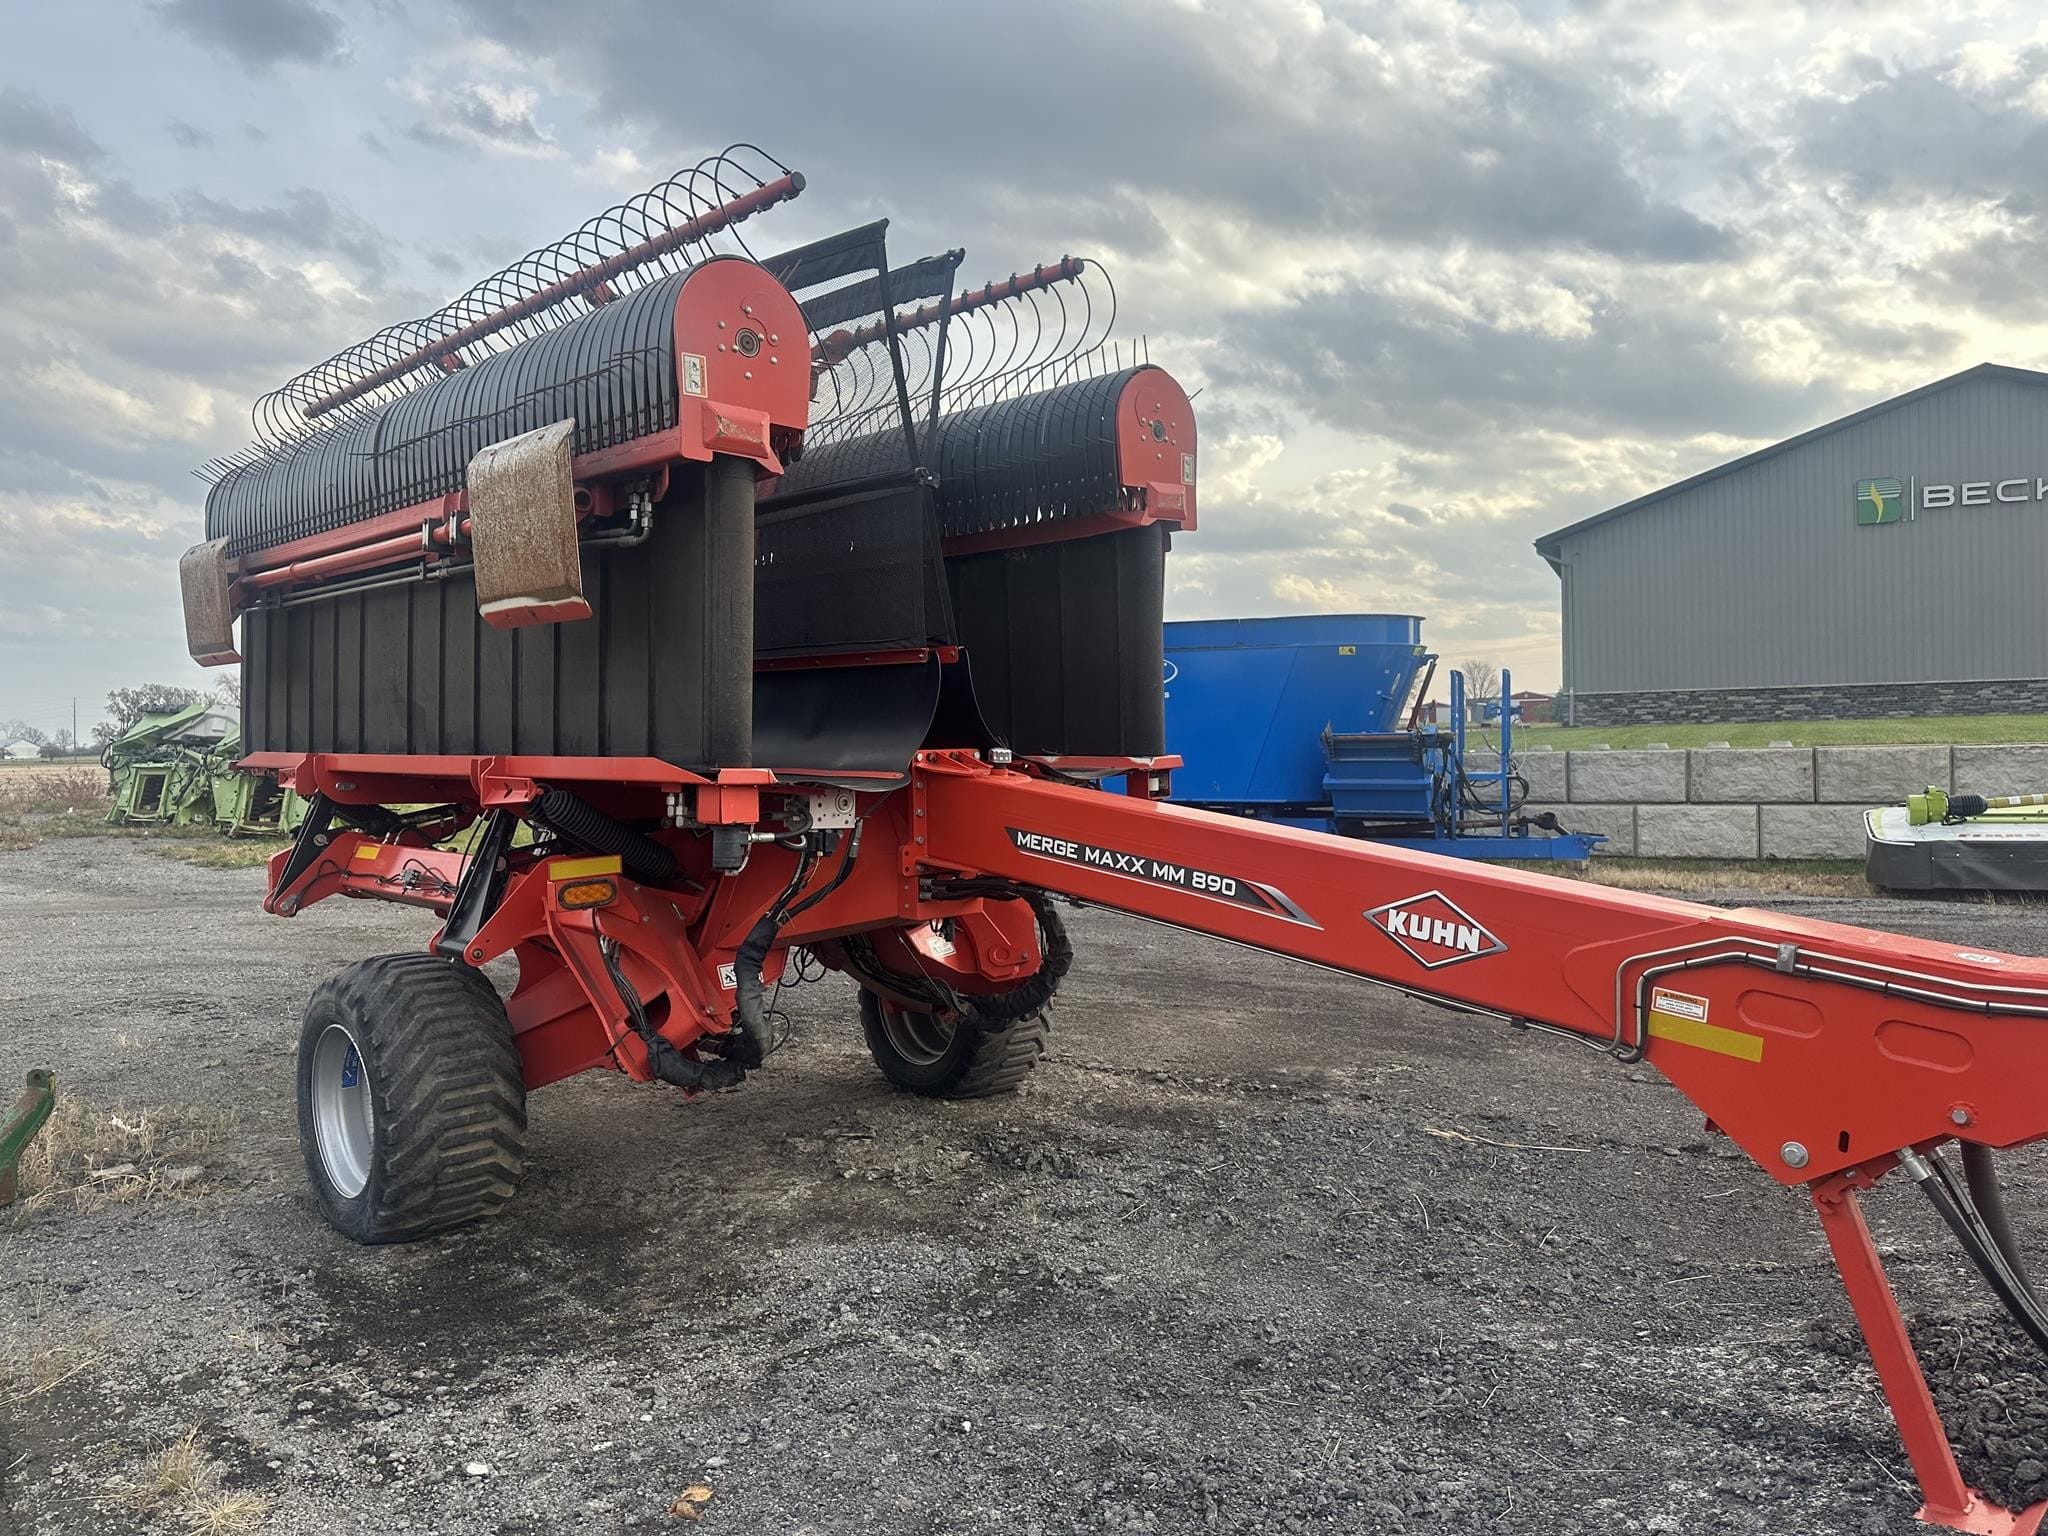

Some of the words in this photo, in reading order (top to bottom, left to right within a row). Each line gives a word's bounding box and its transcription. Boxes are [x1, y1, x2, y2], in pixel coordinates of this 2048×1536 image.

[1016, 831, 1079, 860] MERGE
[1084, 846, 1146, 876] MAXX
[1152, 861, 1185, 885] MM
[1191, 871, 1237, 897] 890
[1387, 907, 1482, 953] KUHN
